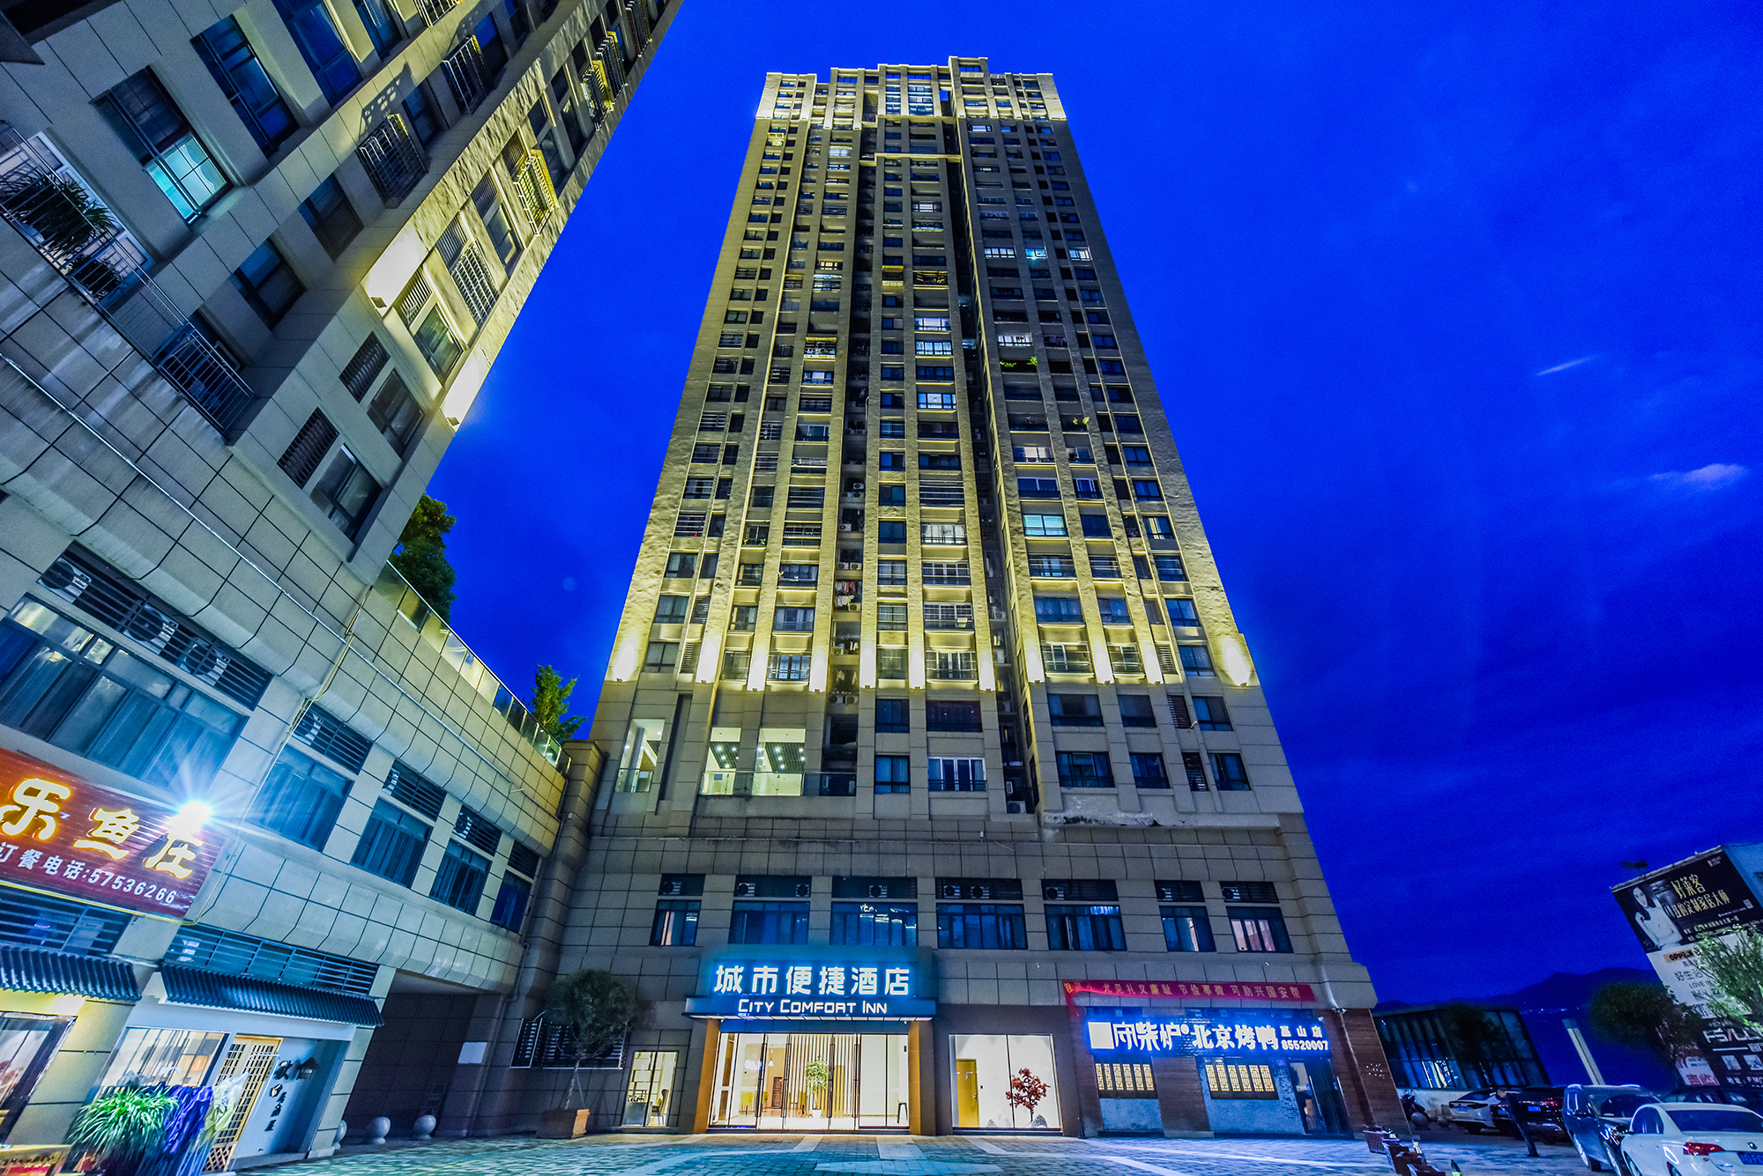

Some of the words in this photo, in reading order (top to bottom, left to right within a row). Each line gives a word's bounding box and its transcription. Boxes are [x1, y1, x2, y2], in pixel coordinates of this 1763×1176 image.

[714, 965, 910, 995] 城市便捷酒店
[738, 999, 774, 1013] CITY
[780, 999, 856, 1013] COMFORT
[862, 1000, 887, 1014] INN
[1281, 1040, 1329, 1051] 85520007
